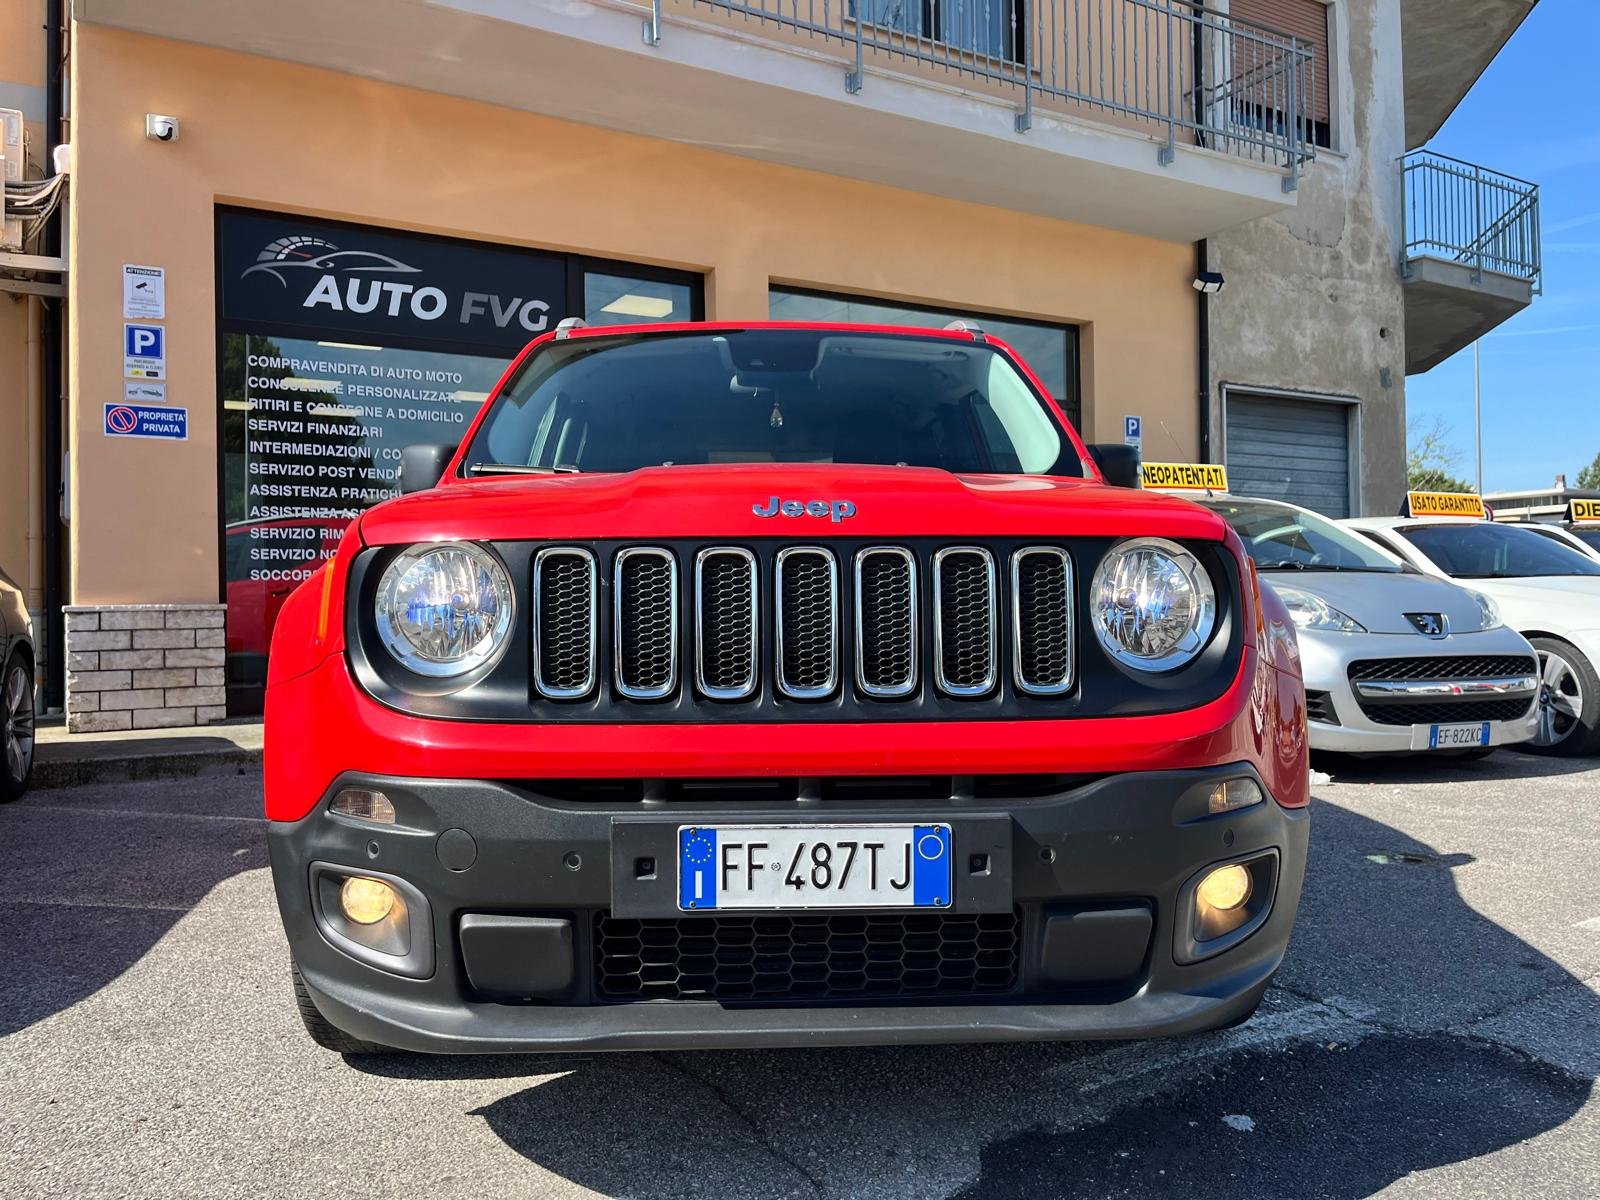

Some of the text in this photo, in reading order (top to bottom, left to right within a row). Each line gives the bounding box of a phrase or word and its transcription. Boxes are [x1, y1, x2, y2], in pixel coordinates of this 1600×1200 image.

[303, 274, 550, 331] AUTO FVG
[134, 329, 156, 354] P
[248, 355, 463, 383] COMPRAVENDITA DI AUTO MOTO
[249, 397, 289, 412] RITIRI
[293, 401, 303, 412] E
[386, 408, 395, 419] A
[398, 409, 464, 423] DOMICILIO
[143, 423, 180, 433] PRIVATA
[248, 418, 383, 438] SERVIZI FINANZIARI
[1128, 419, 1138, 435] P
[250, 441, 401, 460] INTERMEDIAZIONI / CO
[249, 463, 315, 477] SERVIZIO
[319, 465, 355, 478] POST
[1143, 466, 1224, 486] NEOPATENTATI
[250, 484, 338, 498] ASSISTENZA
[752, 496, 857, 523] Jeep
[1411, 495, 1481, 512] USATO GARANTITO
[1574, 503, 1600, 517] DIE
[250, 505, 338, 519] ASSISTENZA
[250, 528, 316, 539] SERVIZIO
[250, 548, 316, 560] SERVIZIO
[250, 569, 317, 581] SOCCOR
[1438, 729, 1451, 744] EF
[720, 842, 769, 891] FF
[784, 841, 911, 891] 487TJ
